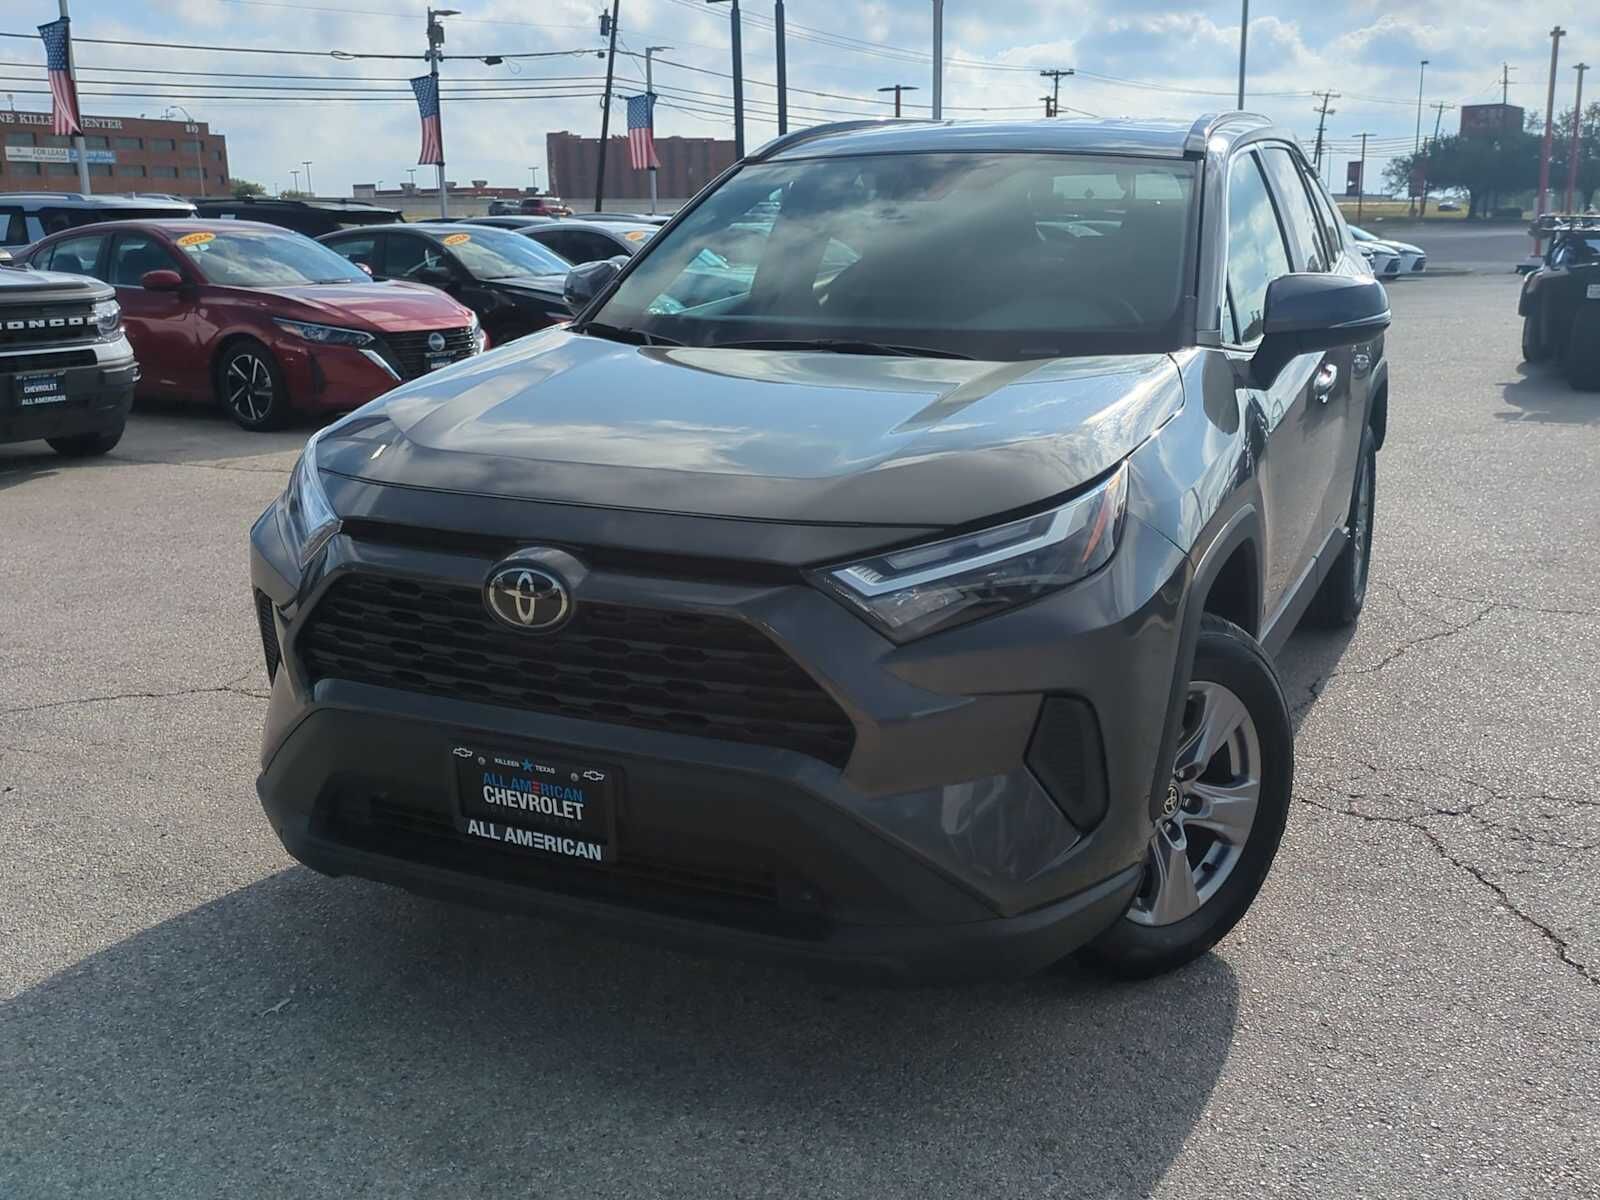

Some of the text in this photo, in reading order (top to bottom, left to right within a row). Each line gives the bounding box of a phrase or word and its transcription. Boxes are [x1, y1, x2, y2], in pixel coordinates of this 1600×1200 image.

[19, 114, 54, 126] KILLE
[0, 317, 83, 330] ONCO
[24, 383, 57, 393] CHEVROLET
[494, 757, 556, 774] KILLEEN TEXAS
[483, 772, 583, 801] ALL AMERICAN
[482, 785, 584, 821] CHEVROLET
[467, 819, 602, 861] ALL AMERICAN
